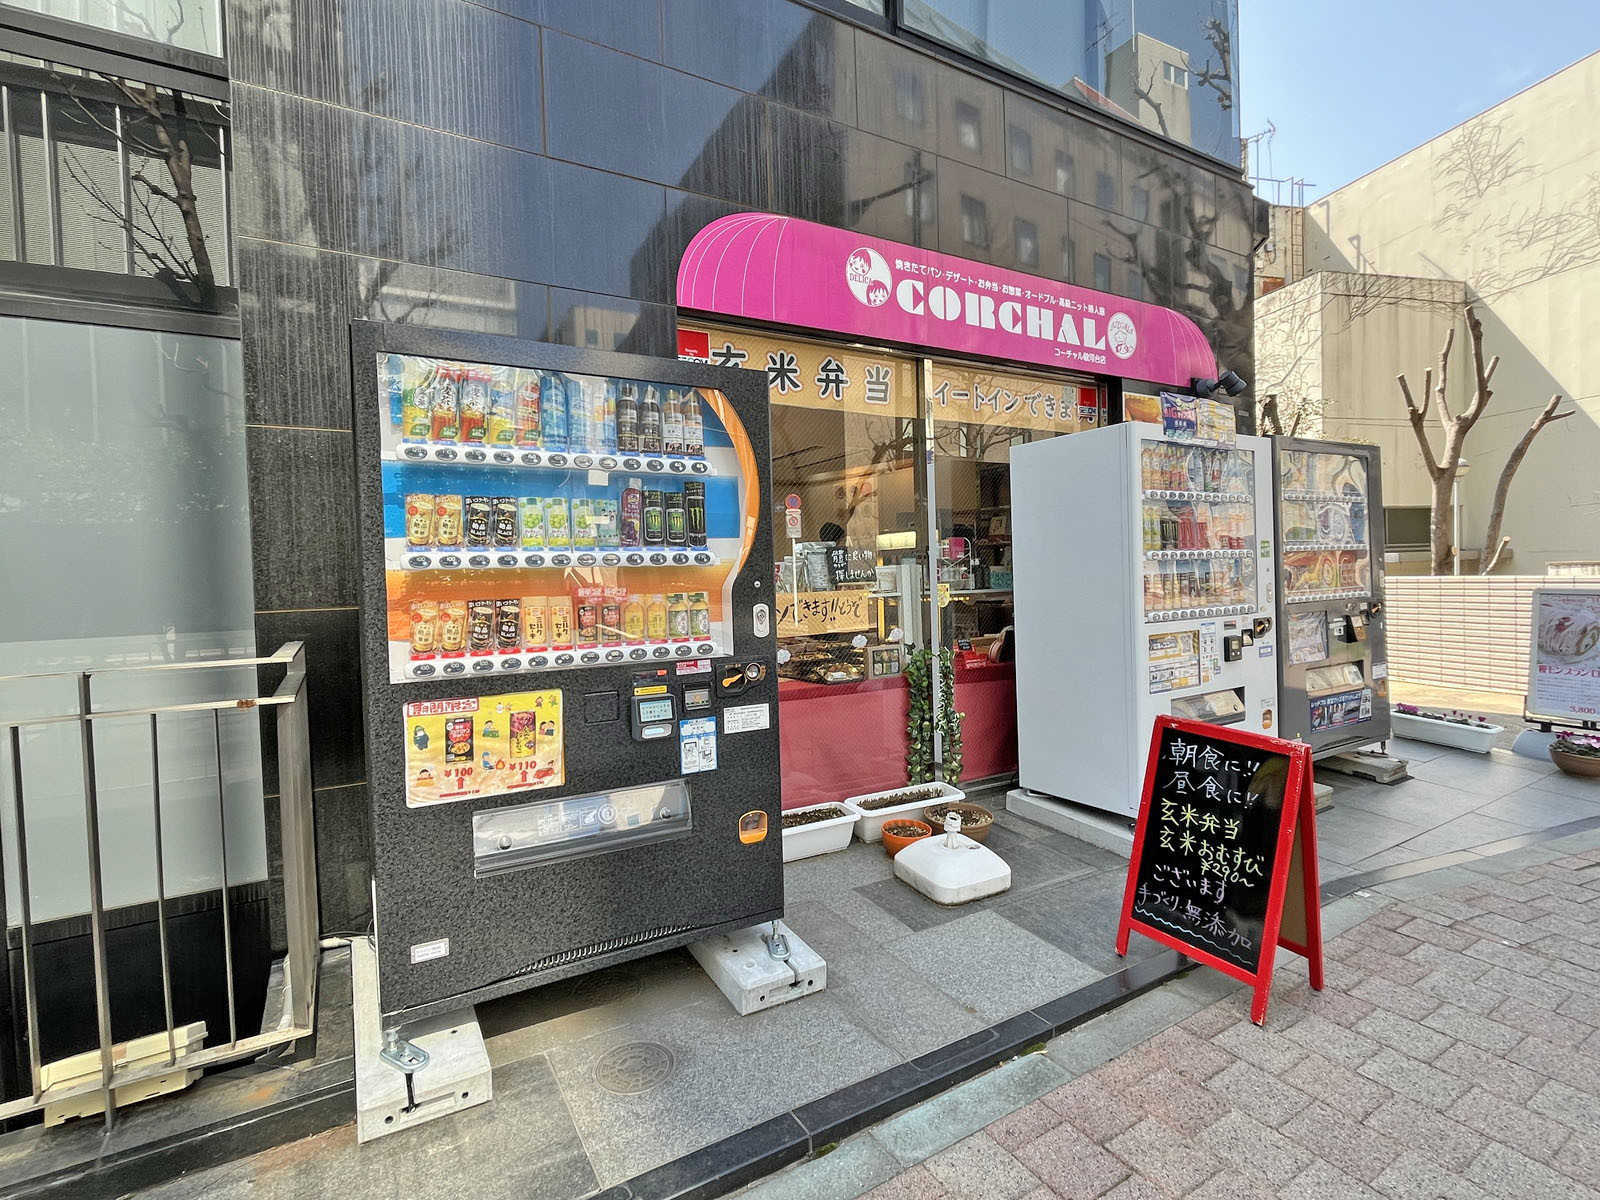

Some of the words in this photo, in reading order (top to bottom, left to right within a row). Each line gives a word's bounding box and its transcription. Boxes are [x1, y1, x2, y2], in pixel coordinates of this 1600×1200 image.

[896, 279, 1106, 351] CORCHAL
[935, 382, 1097, 423] イートインできま
[411, 700, 478, 715] 期間限定
[1569, 705, 1596, 715] 3,800
[1160, 798, 1240, 841] 玄米弁当
[1159, 825, 1265, 877] 玄米おむすび
[1153, 863, 1228, 904] ございます
